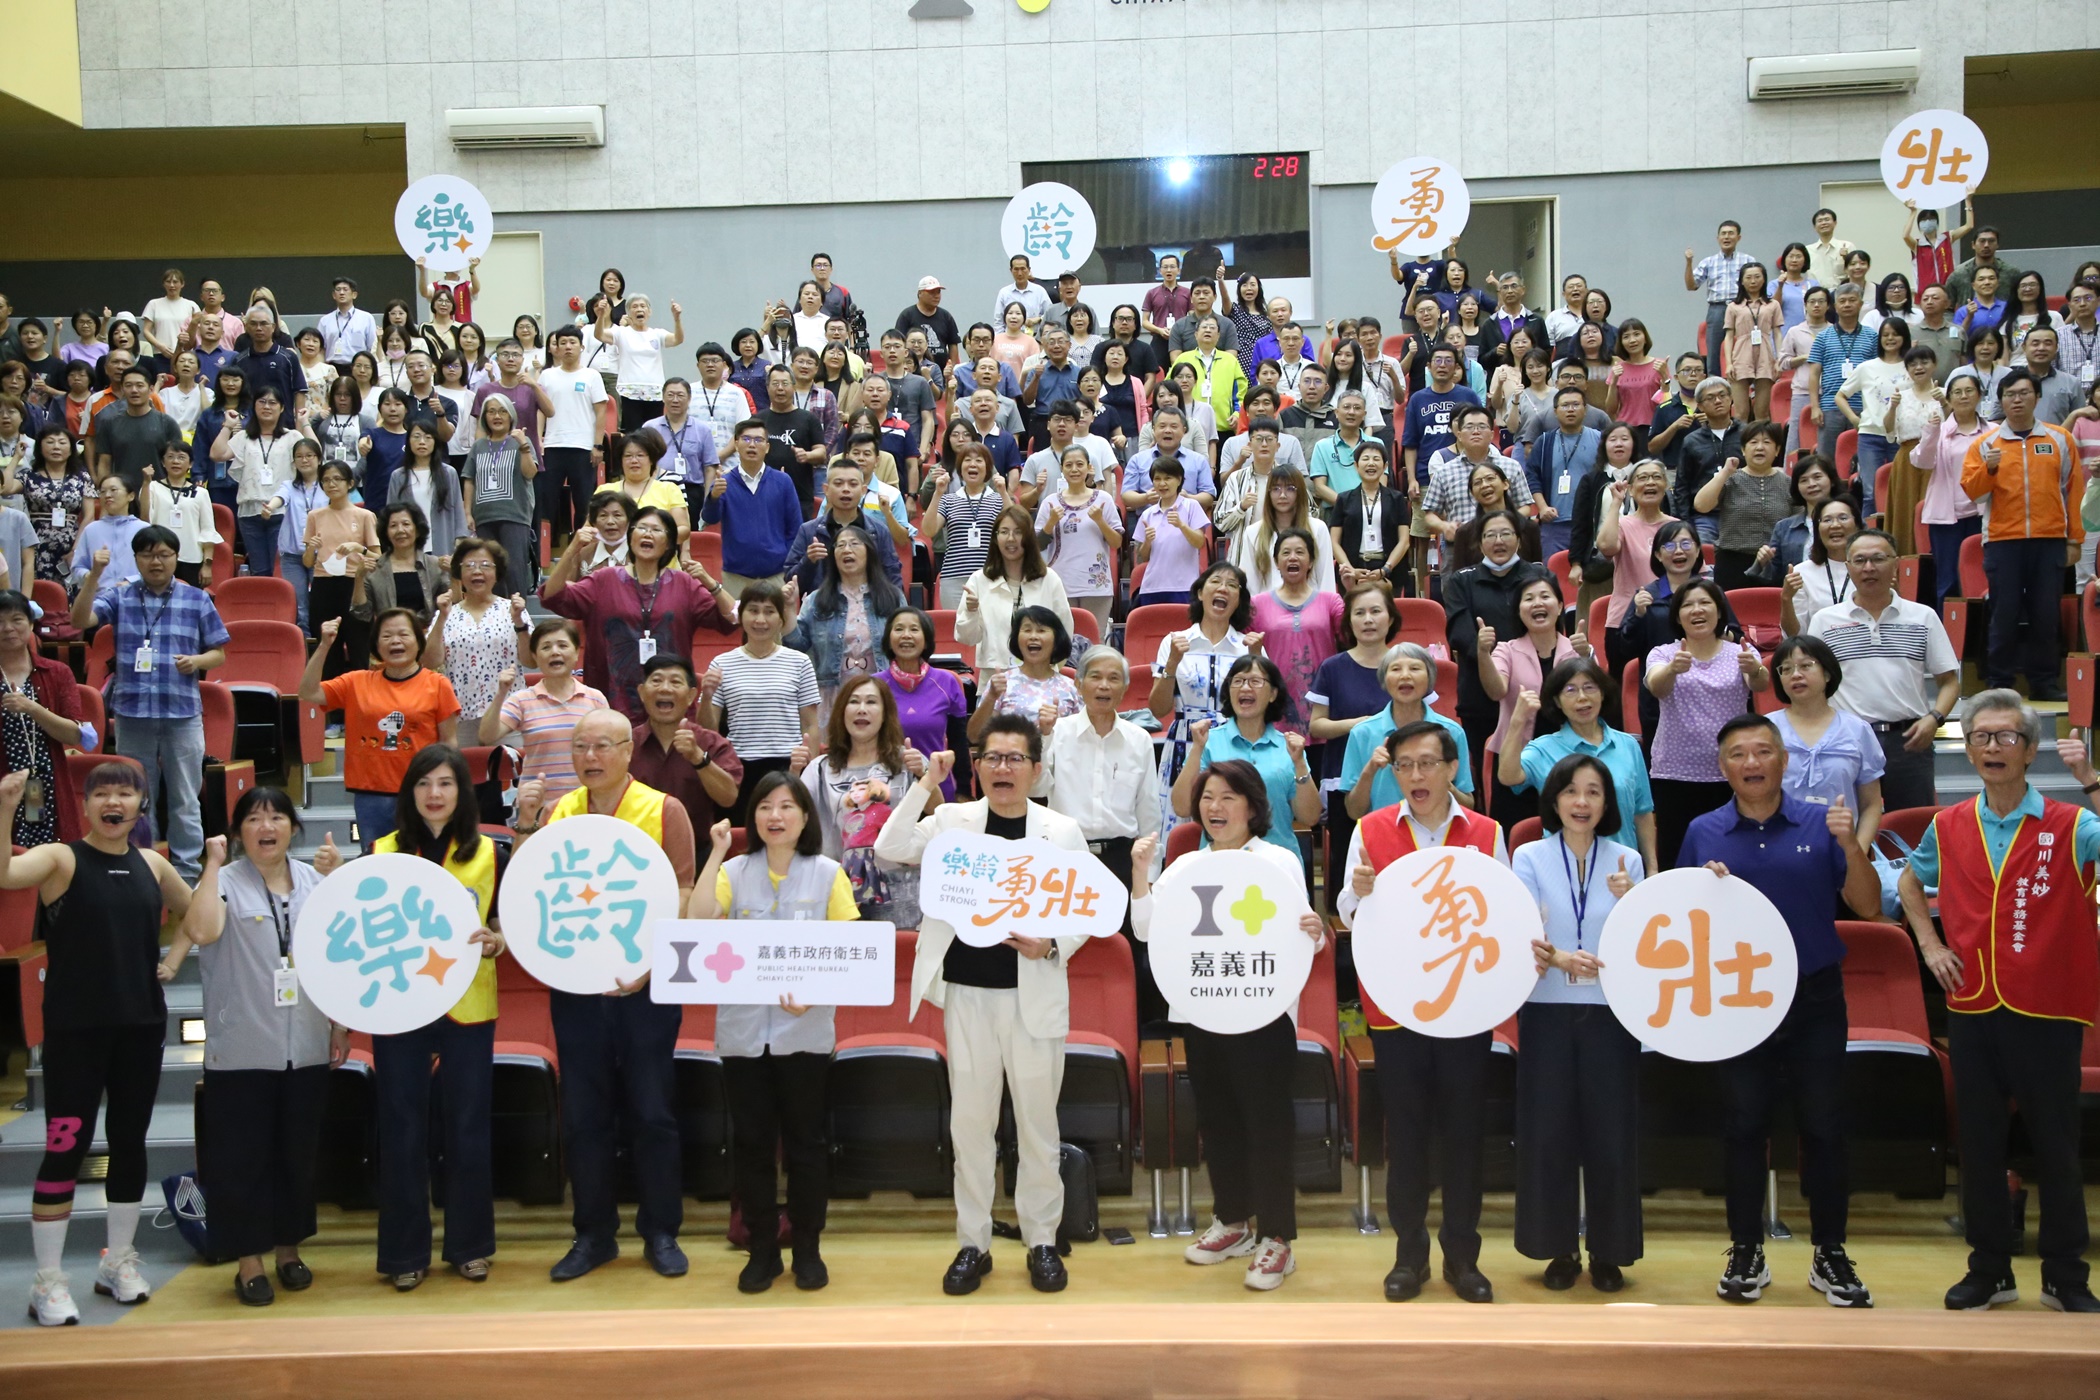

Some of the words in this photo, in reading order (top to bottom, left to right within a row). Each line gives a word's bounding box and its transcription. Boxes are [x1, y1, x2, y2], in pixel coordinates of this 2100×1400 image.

[1896, 127, 1973, 190] 壯
[414, 192, 475, 254] 樂
[1023, 202, 1075, 260] 齡
[1373, 166, 1444, 250] 勇
[535, 839, 650, 965] 齡
[939, 894, 977, 907] STRONG
[941, 883, 975, 896] CHIAYI
[942, 847, 1000, 883] 樂齡
[971, 855, 1100, 927] 勇壯
[2011, 877, 2029, 953] 教育事務基金會
[326, 876, 457, 1008] 樂
[757, 945, 878, 961] 嘉義市政府衛生局
[1190, 950, 1277, 977] 嘉義市
[1411, 855, 1500, 1022] 勇
[1635, 909, 1774, 1028] 壯
[1190, 987, 1238, 997] CHIAYI
[1243, 987, 1275, 997] CITY
